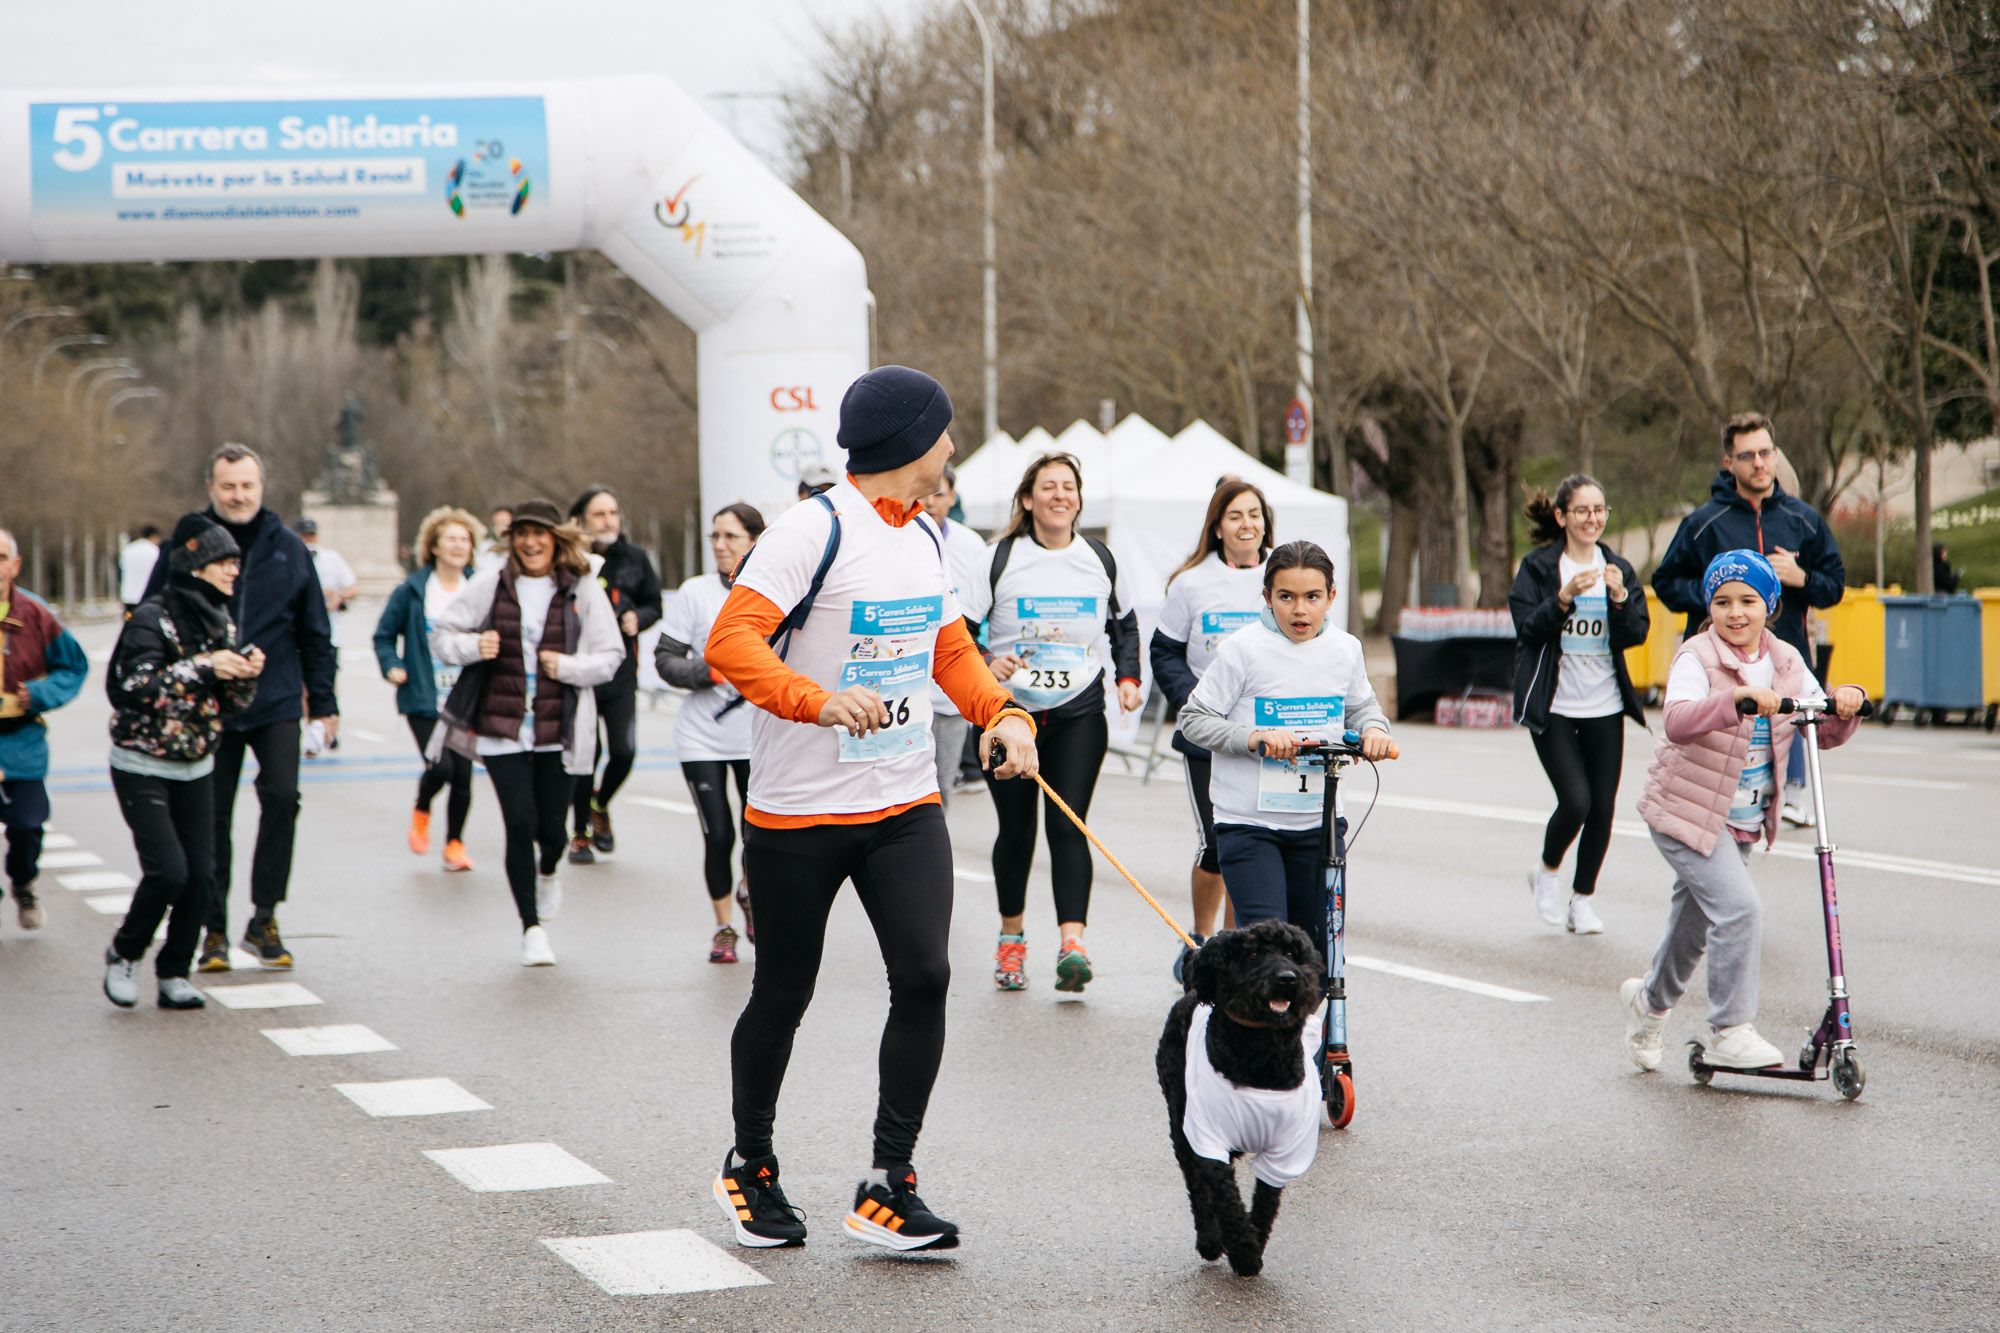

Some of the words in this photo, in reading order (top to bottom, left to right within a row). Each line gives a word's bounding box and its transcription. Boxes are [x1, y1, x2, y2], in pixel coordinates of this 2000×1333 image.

[108, 117, 268, 152] Carrera
[279, 113, 458, 151] Solidaria
[224, 174, 256, 192] por
[290, 167, 348, 184] Salud
[770, 385, 821, 412] CSL
[878, 607, 905, 617] Carrera
[905, 604, 934, 615] Solidaria
[1562, 619, 1602, 636] 400
[859, 668, 892, 677] Carrera
[1029, 670, 1070, 689] 233
[1306, 702, 1335, 710] Solidaria
[1298, 774, 1308, 793] 1
[1750, 789, 1759, 806] 1
